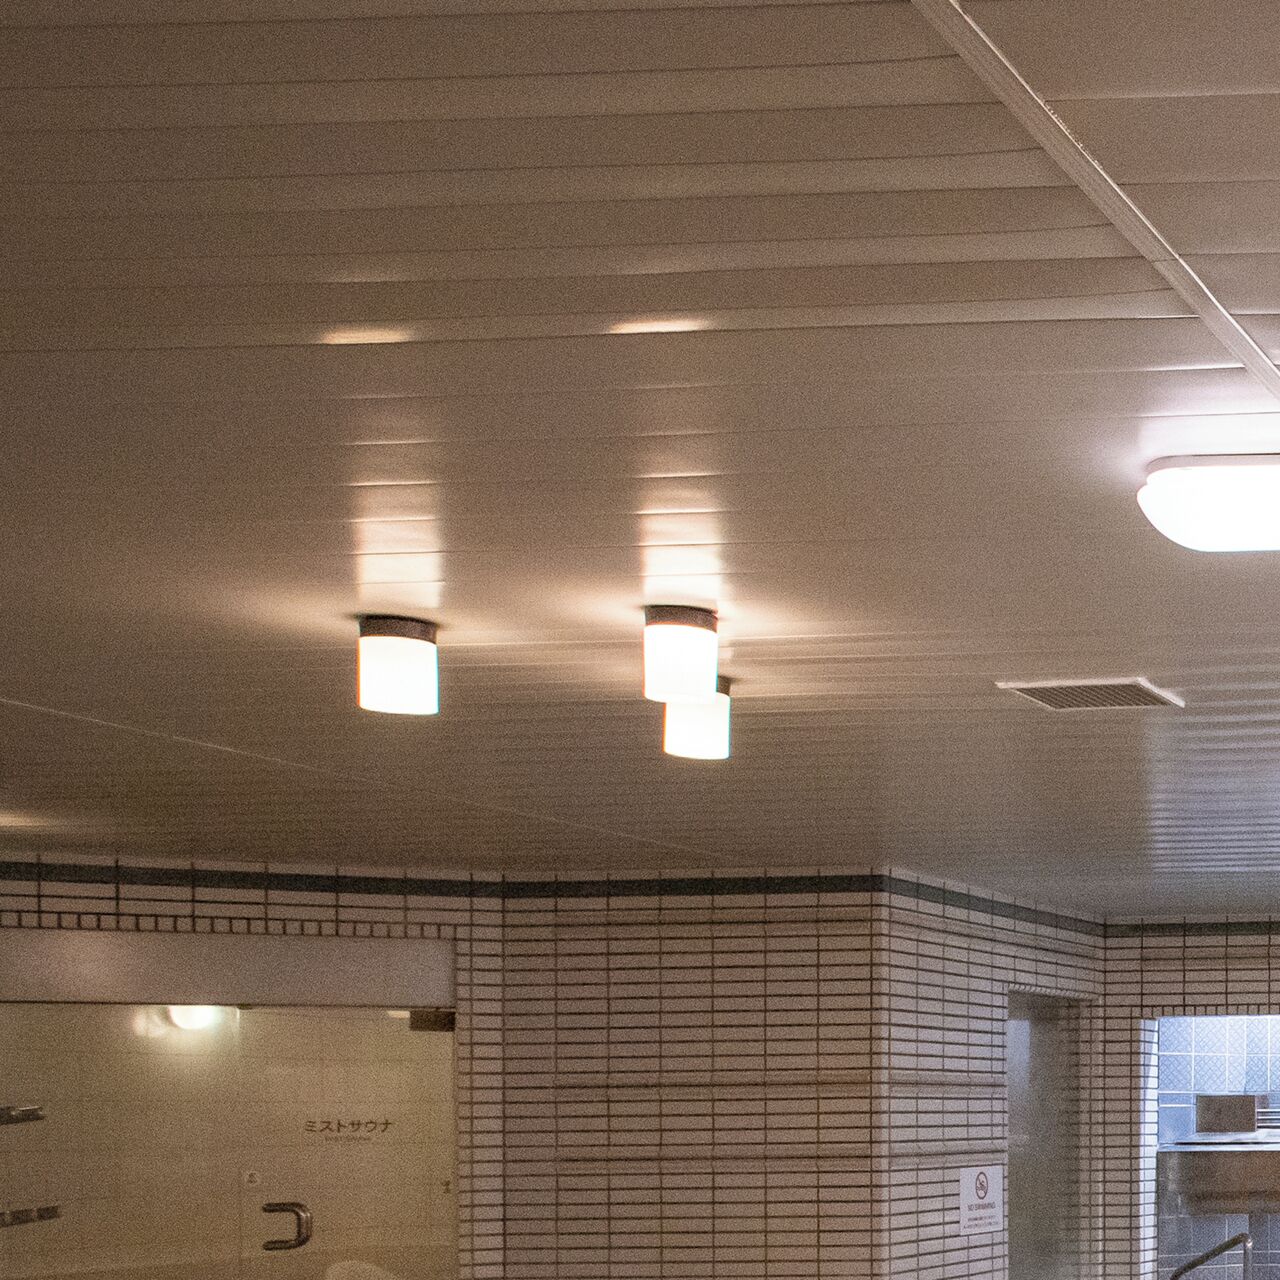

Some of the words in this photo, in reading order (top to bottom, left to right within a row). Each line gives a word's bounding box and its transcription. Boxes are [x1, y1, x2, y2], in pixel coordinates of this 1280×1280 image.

[304, 1119, 393, 1133] ミストサウナ
